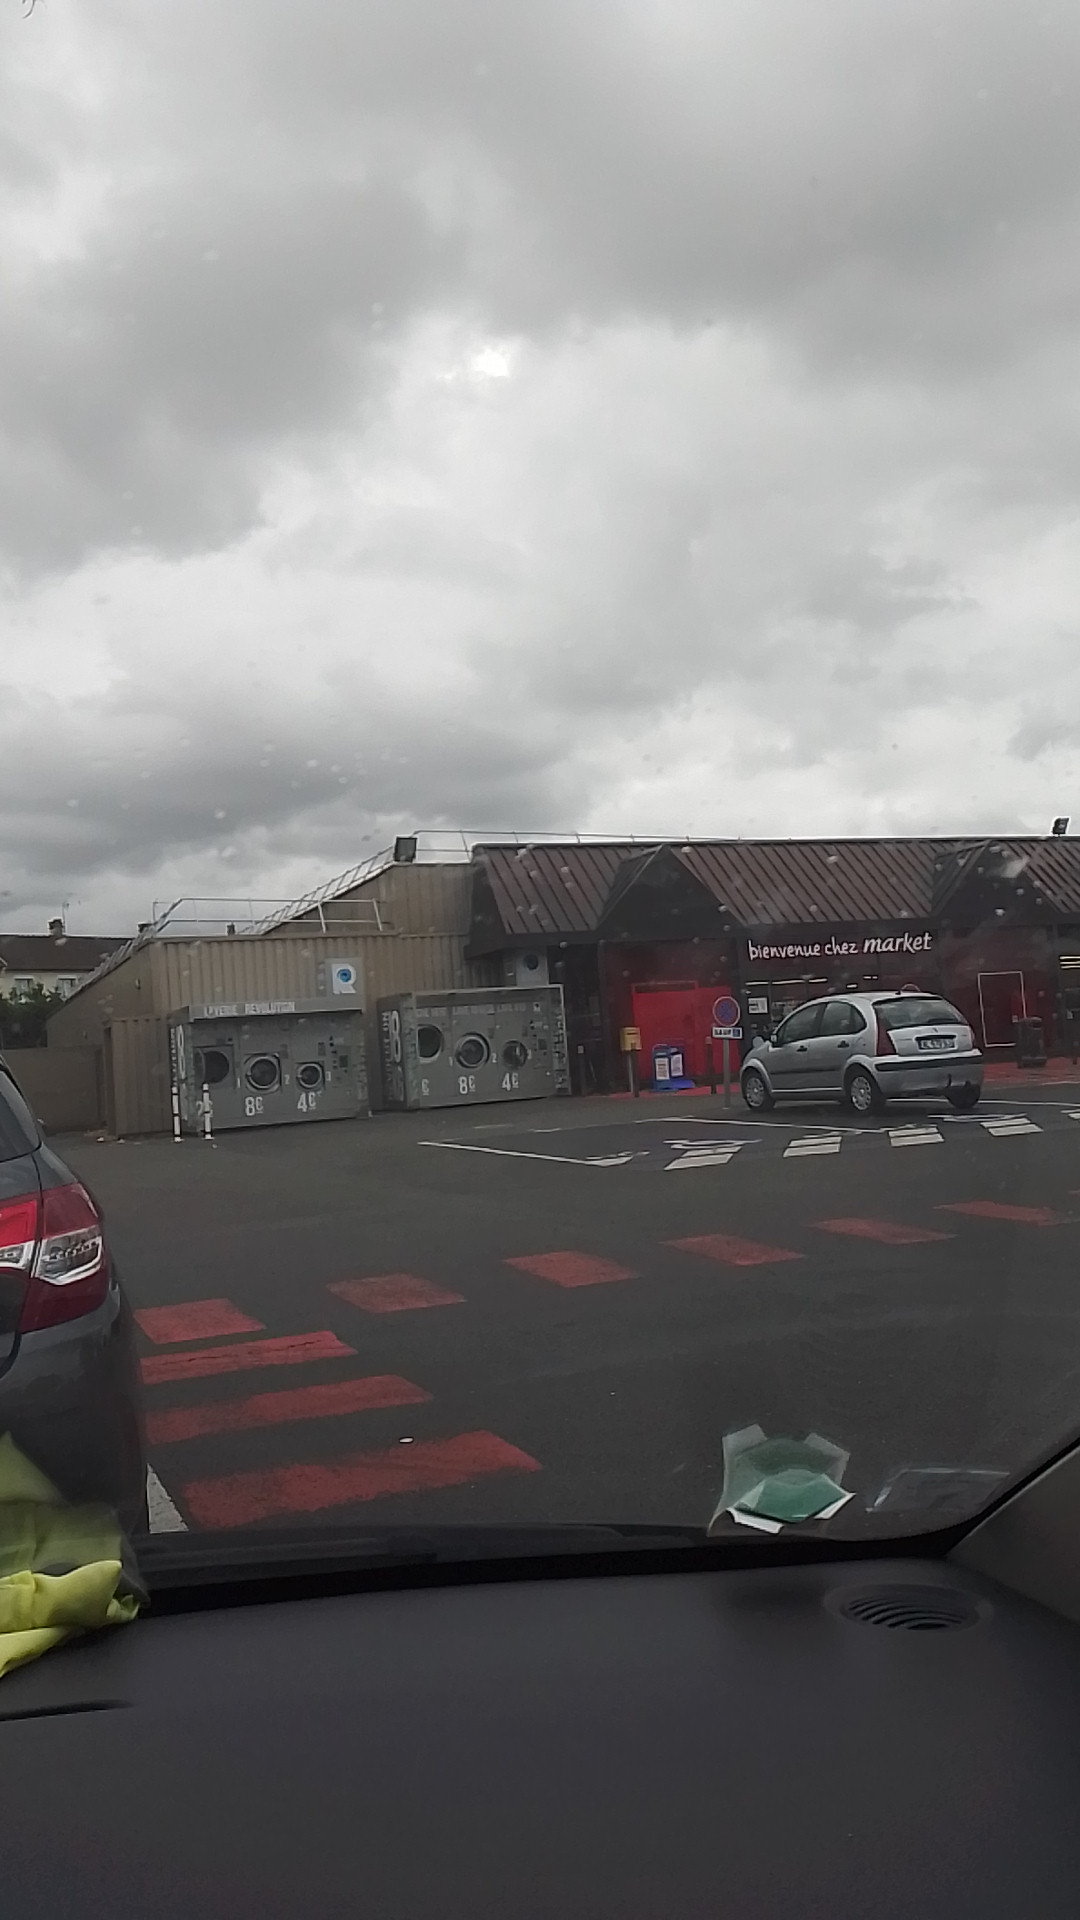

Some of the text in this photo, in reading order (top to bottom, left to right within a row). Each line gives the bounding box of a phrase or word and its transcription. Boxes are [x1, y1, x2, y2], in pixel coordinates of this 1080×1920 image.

[748, 932, 932, 961] bienvenue chez market
